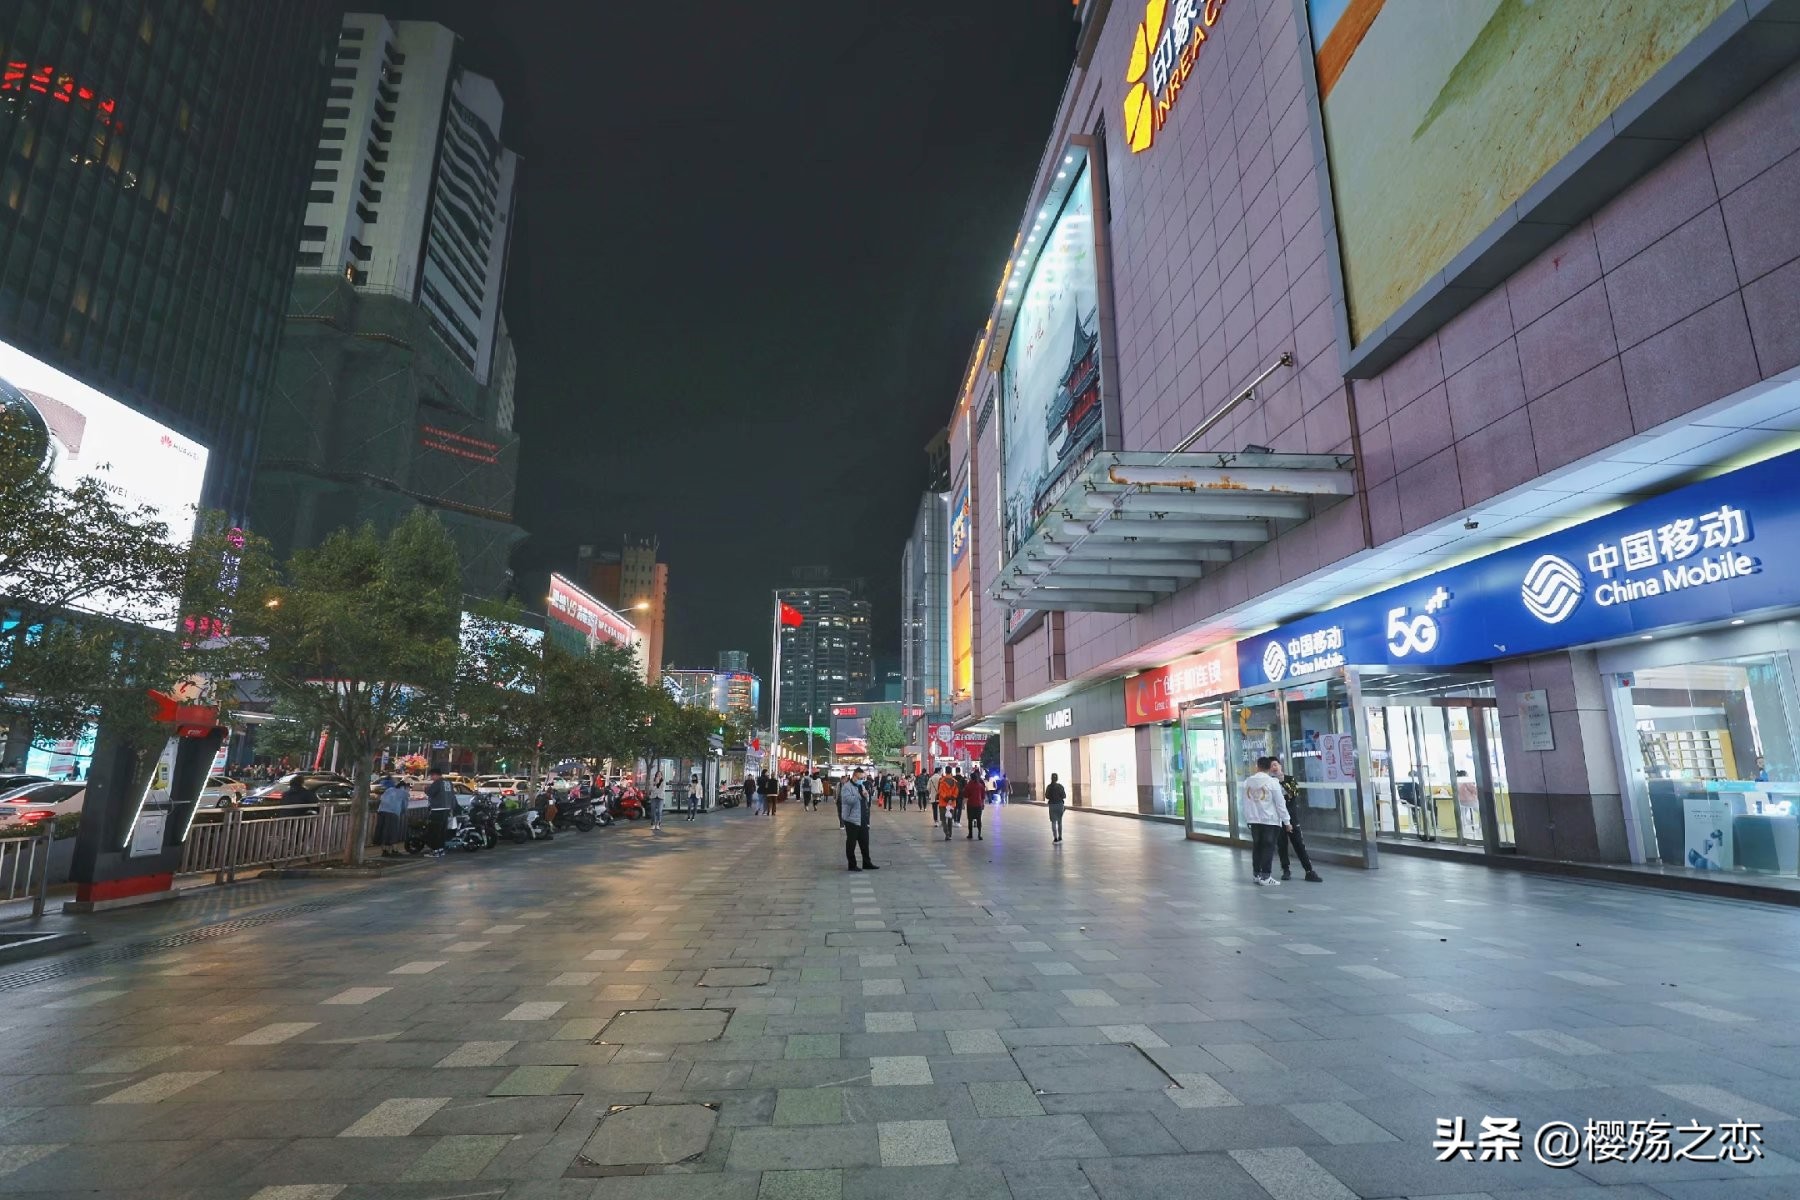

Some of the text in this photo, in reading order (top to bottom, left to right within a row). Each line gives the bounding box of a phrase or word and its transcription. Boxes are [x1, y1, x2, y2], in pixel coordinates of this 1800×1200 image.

[1152, 0, 1205, 97] 印象
[1155, 0, 1226, 131] INREAC
[1588, 505, 1746, 579] 中国移动
[1595, 551, 1752, 606] China Mobile
[1287, 625, 1343, 660] 中国移动
[1289, 651, 1344, 677] China Mobile
[1045, 707, 1072, 731] HUAWEI
